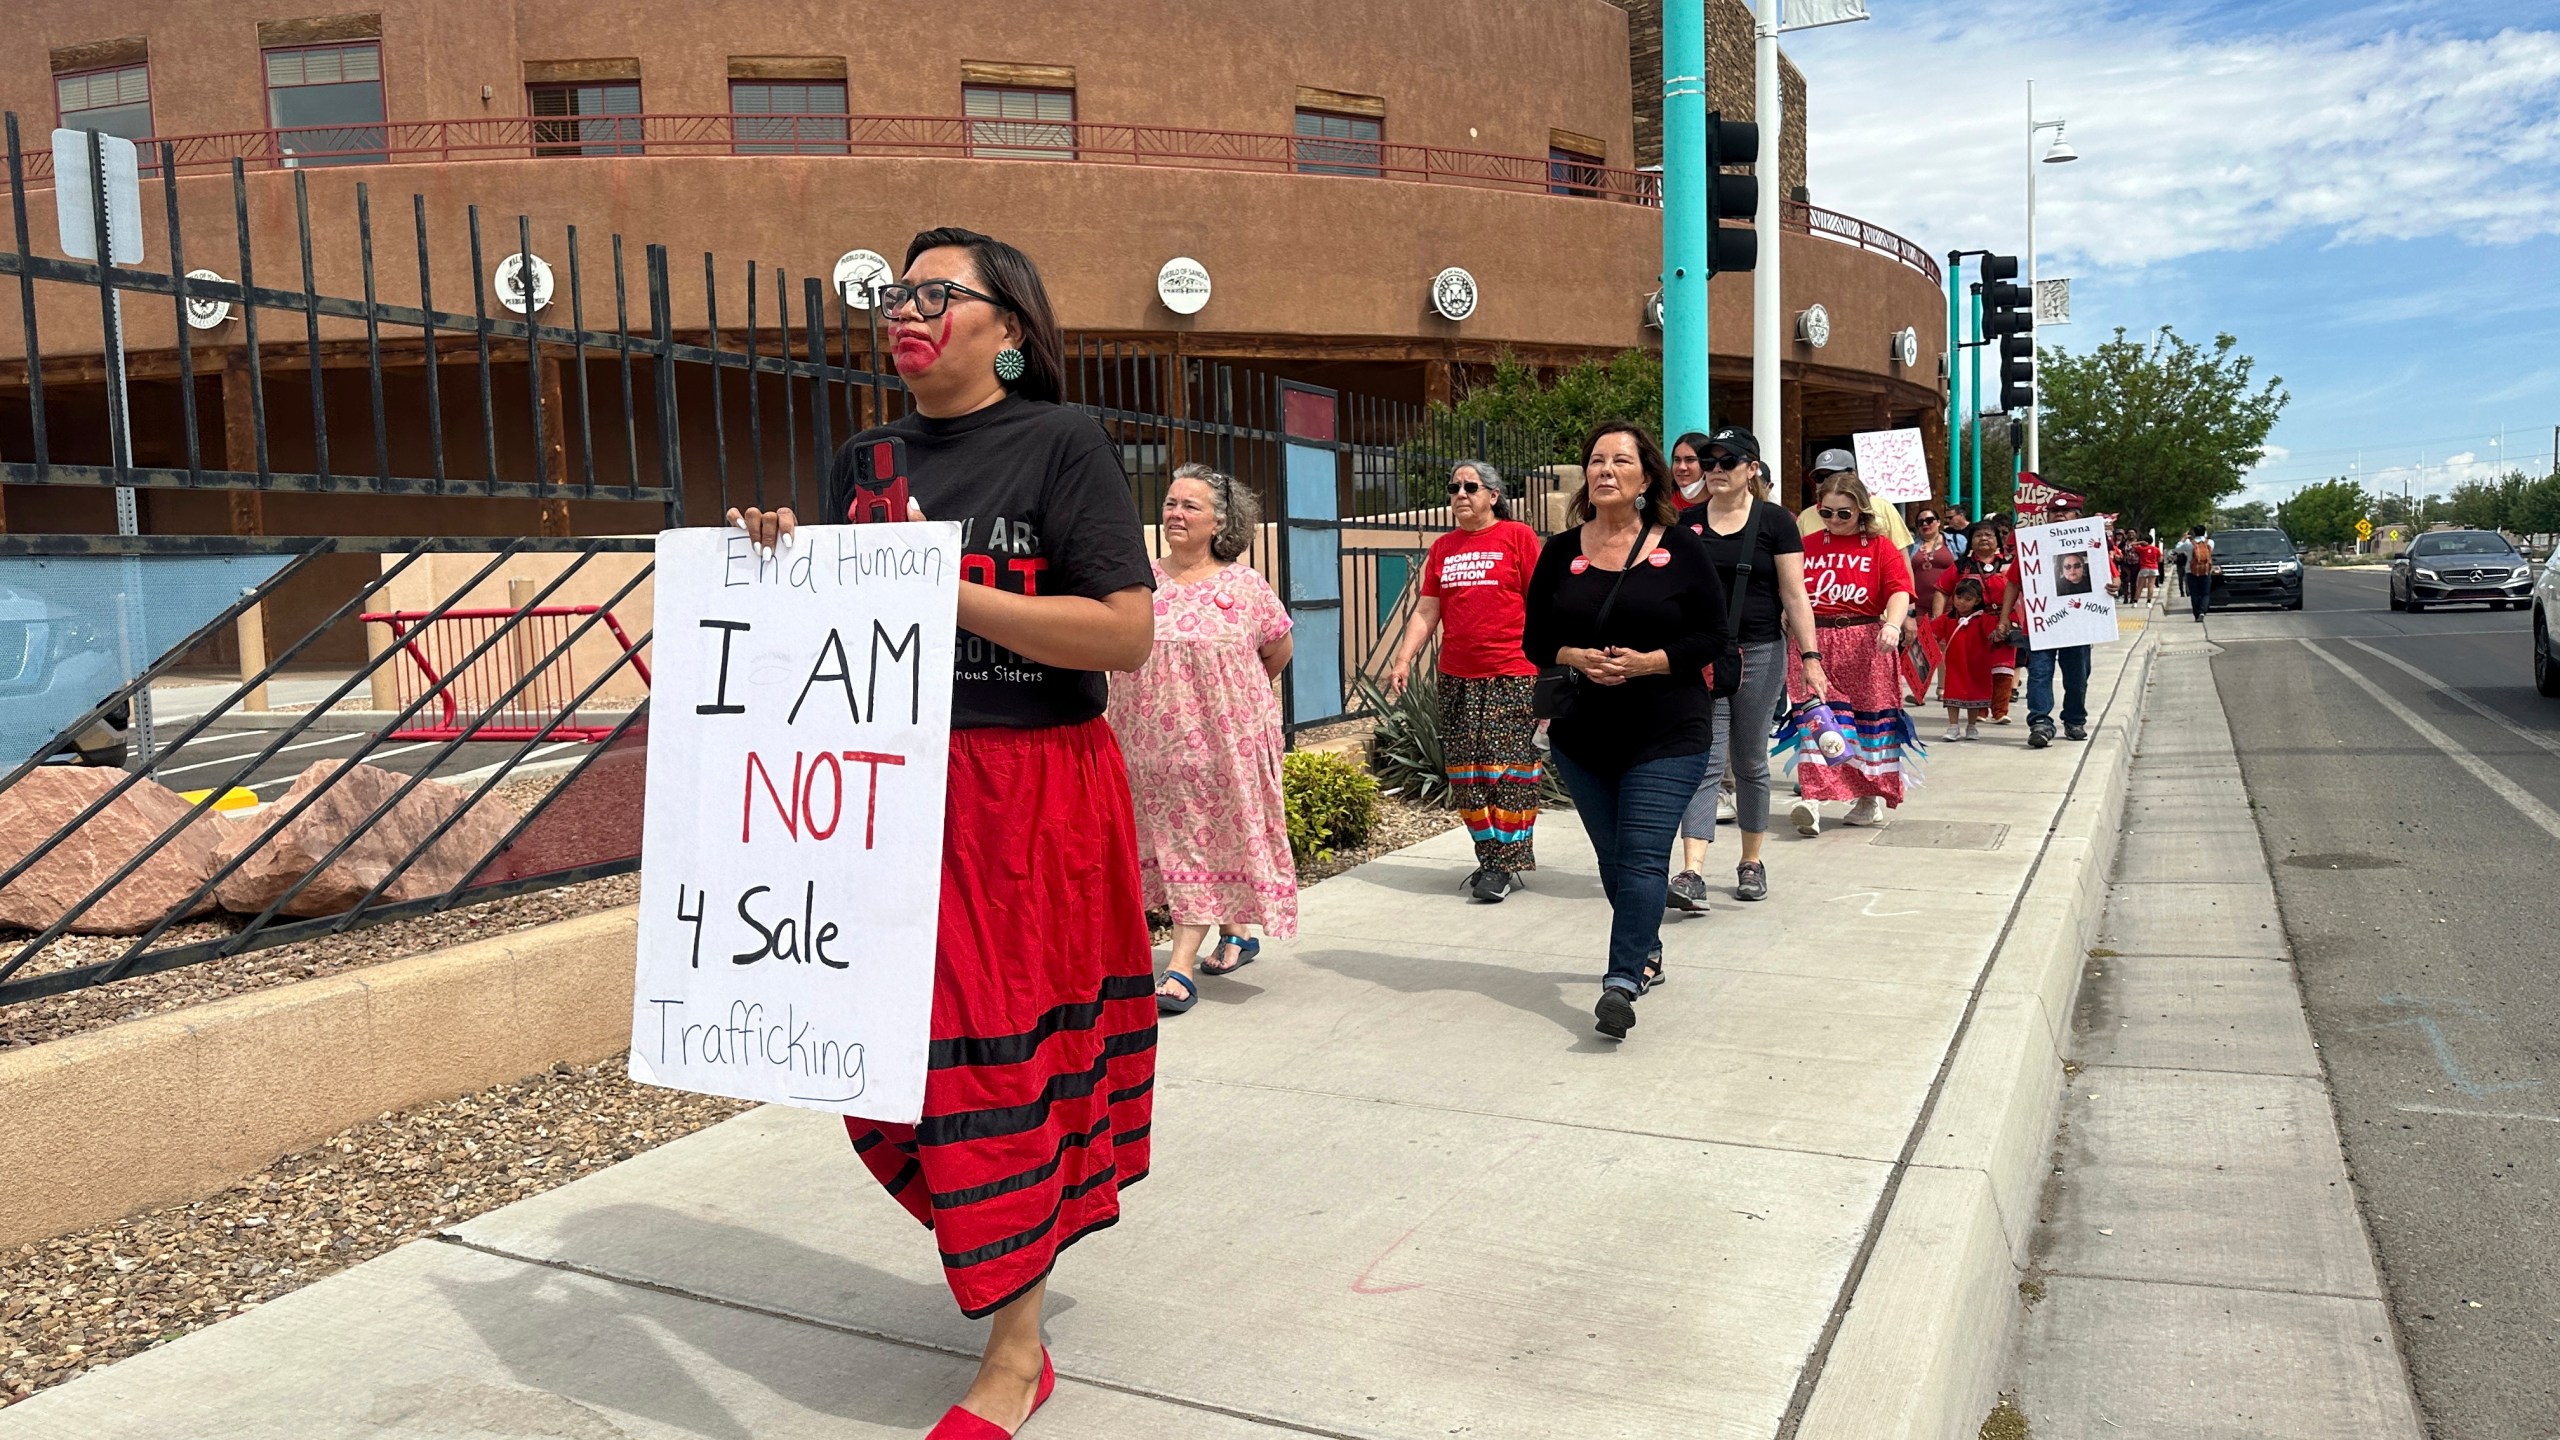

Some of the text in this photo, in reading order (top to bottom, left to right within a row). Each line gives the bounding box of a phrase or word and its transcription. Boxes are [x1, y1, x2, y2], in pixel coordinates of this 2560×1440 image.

[2049, 525, 2091, 538] Shawna
[2059, 538, 2084, 549] Toya
[724, 535, 817, 594] End
[838, 529, 943, 587] Human
[1441, 560, 1495, 575] DEMAND
[1443, 551, 1481, 565] MOMS
[1803, 553, 1872, 573] NATIVE
[1440, 569, 1487, 583] ACTION
[1803, 569, 1869, 607] Love
[2045, 601, 2111, 628] HONK HONK
[696, 618, 921, 726] I AM
[994, 664, 1043, 683] Sisters
[742, 750, 906, 850] NOT
[677, 880, 850, 969] 4 Sale
[650, 999, 866, 1102] Trafficking
